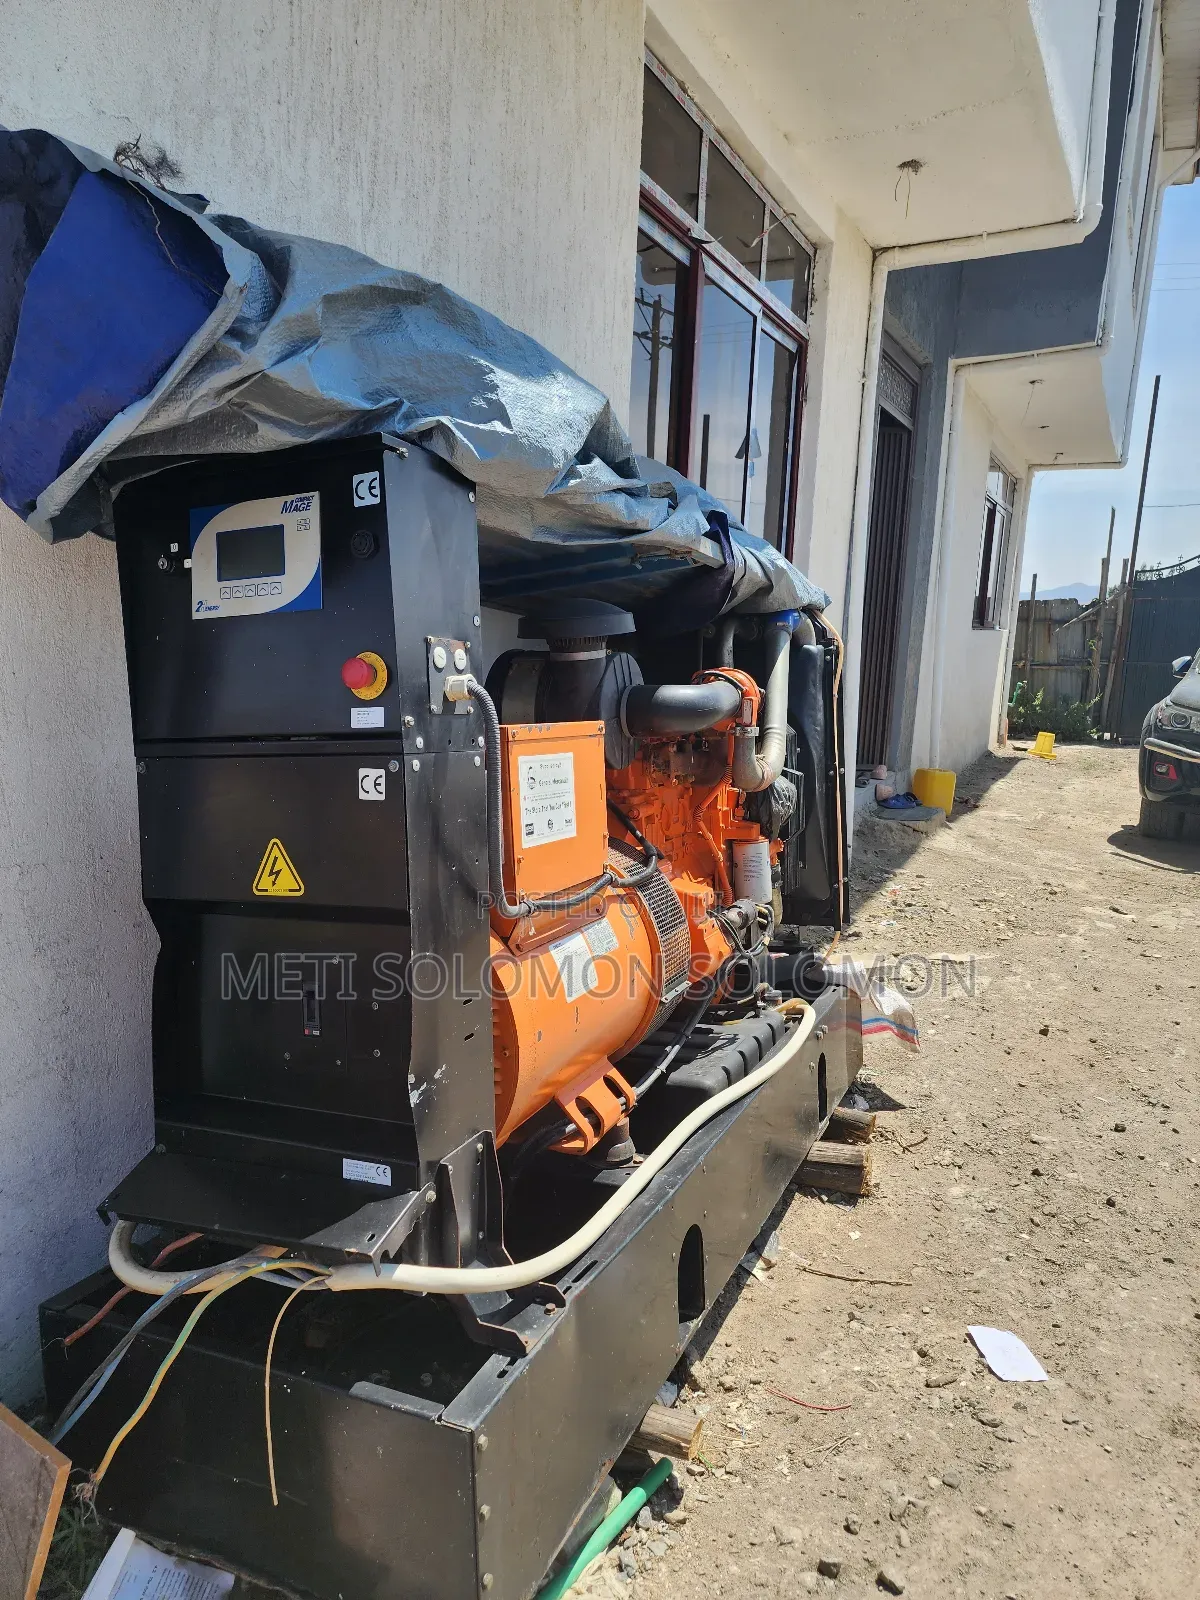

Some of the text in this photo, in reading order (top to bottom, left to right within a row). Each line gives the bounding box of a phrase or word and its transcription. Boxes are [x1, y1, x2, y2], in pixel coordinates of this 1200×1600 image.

[355, 477, 378, 500] CE
[281, 500, 312, 514] MAGE
[361, 774, 383, 794] CE
